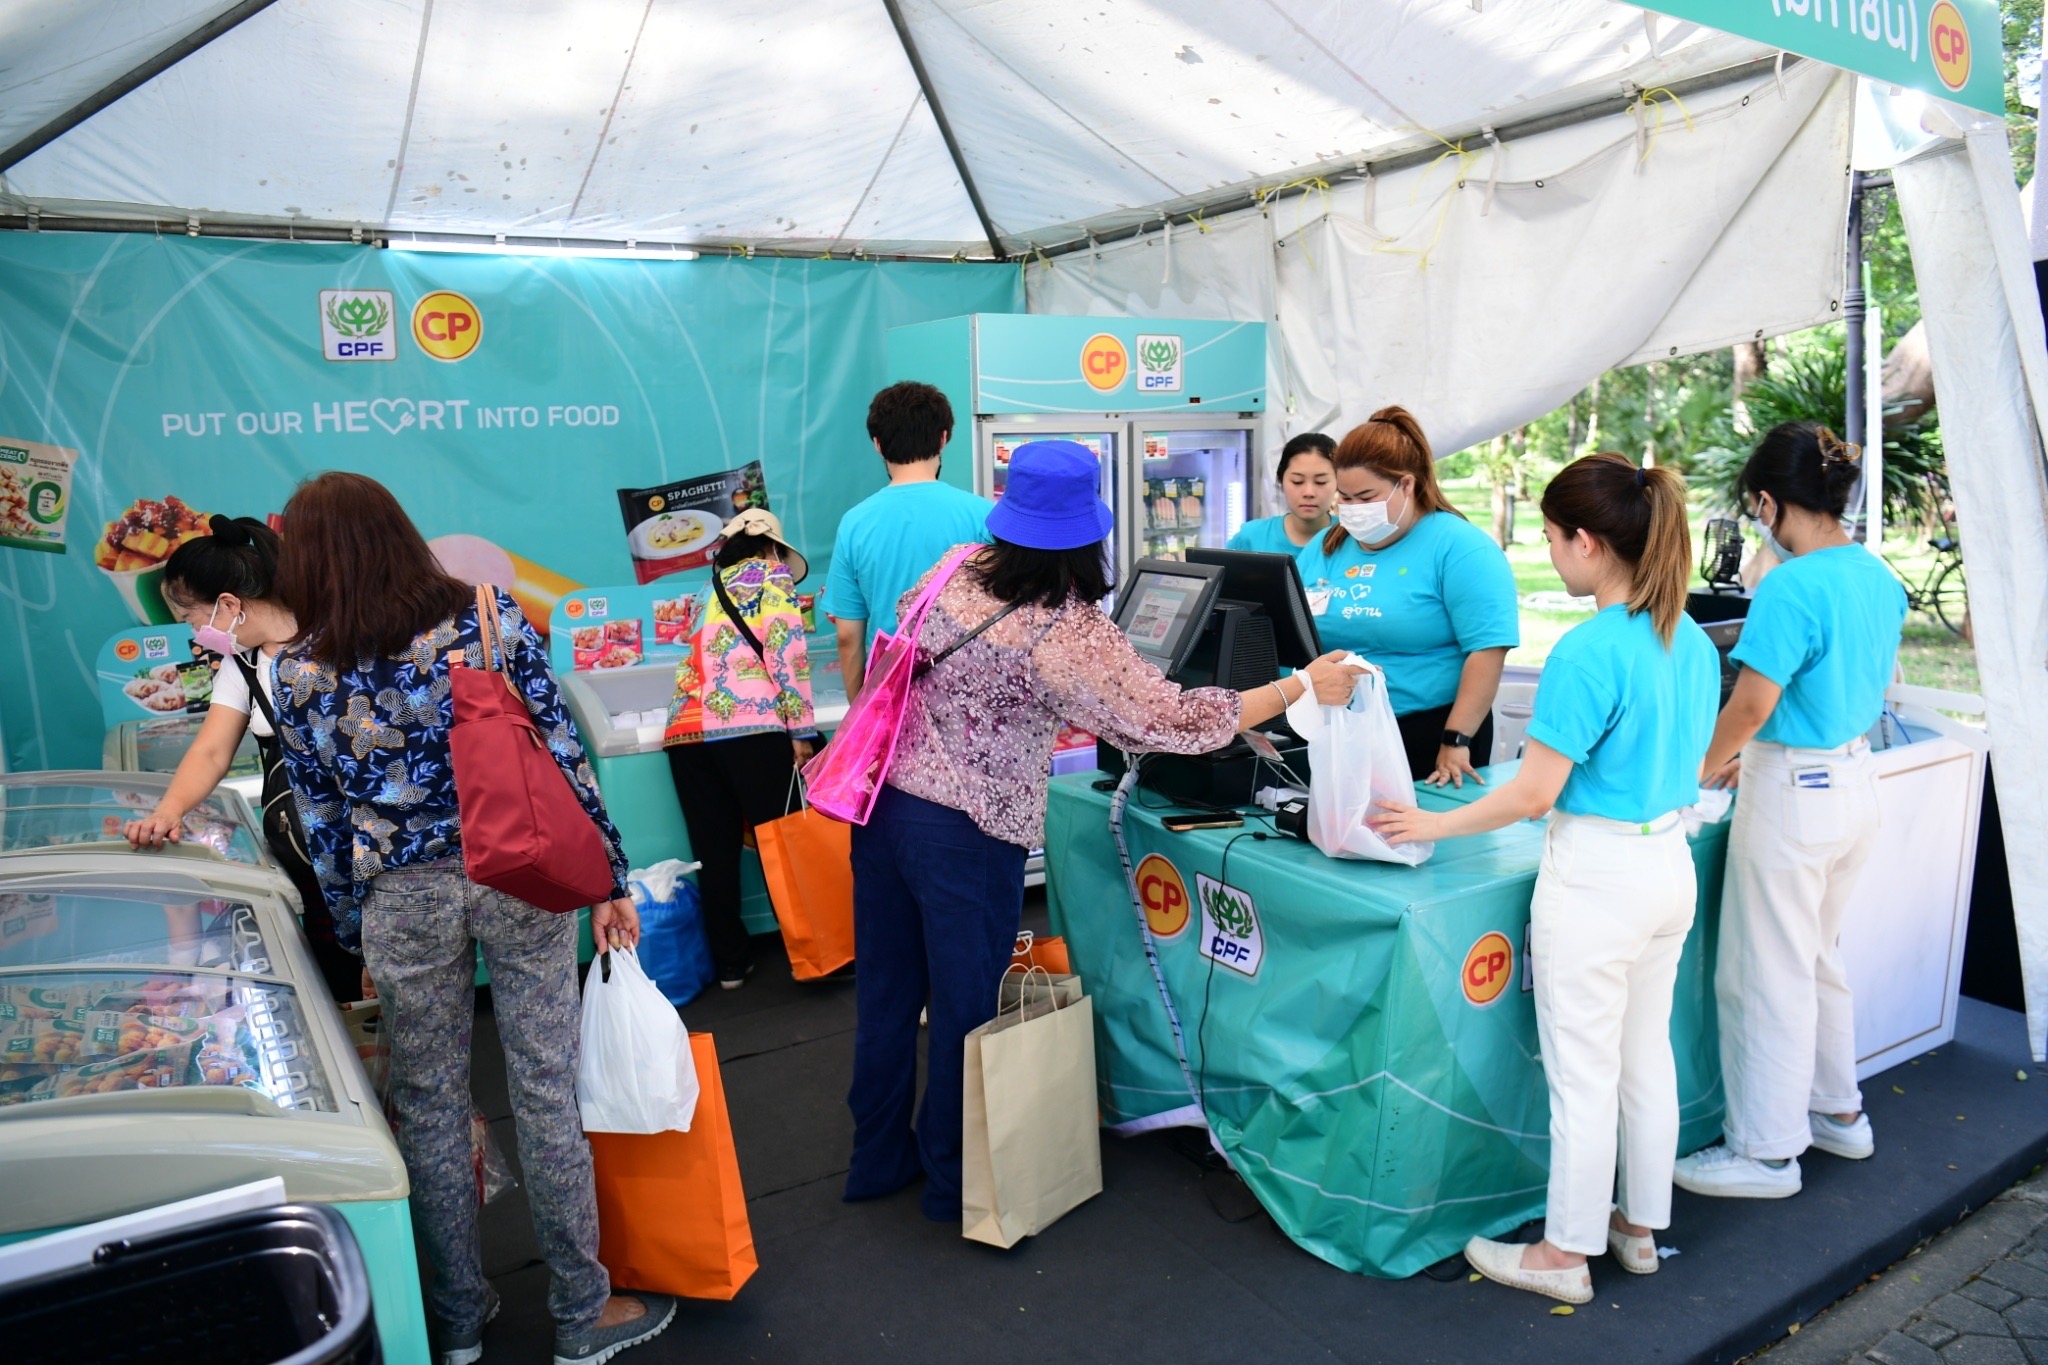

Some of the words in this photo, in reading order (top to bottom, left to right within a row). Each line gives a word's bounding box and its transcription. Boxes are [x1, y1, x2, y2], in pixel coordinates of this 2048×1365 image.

[1934, 24, 1965, 65] CP
[421, 311, 472, 341] CP
[337, 342, 384, 357] CPF
[1087, 350, 1122, 375] CP
[1145, 376, 1174, 388] CPF
[161, 413, 227, 437] PUT
[237, 411, 303, 435] OUR
[477, 406, 539, 429] INTO
[548, 405, 620, 427] FOOD
[651, 499, 663, 507] CP
[667, 480, 727, 501] SPAGHETTI
[568, 604, 582, 613] CP
[119, 645, 136, 655] CP
[1141, 875, 1182, 914] CP
[1211, 936, 1251, 963] CPF
[1468, 951, 1506, 987] CP
